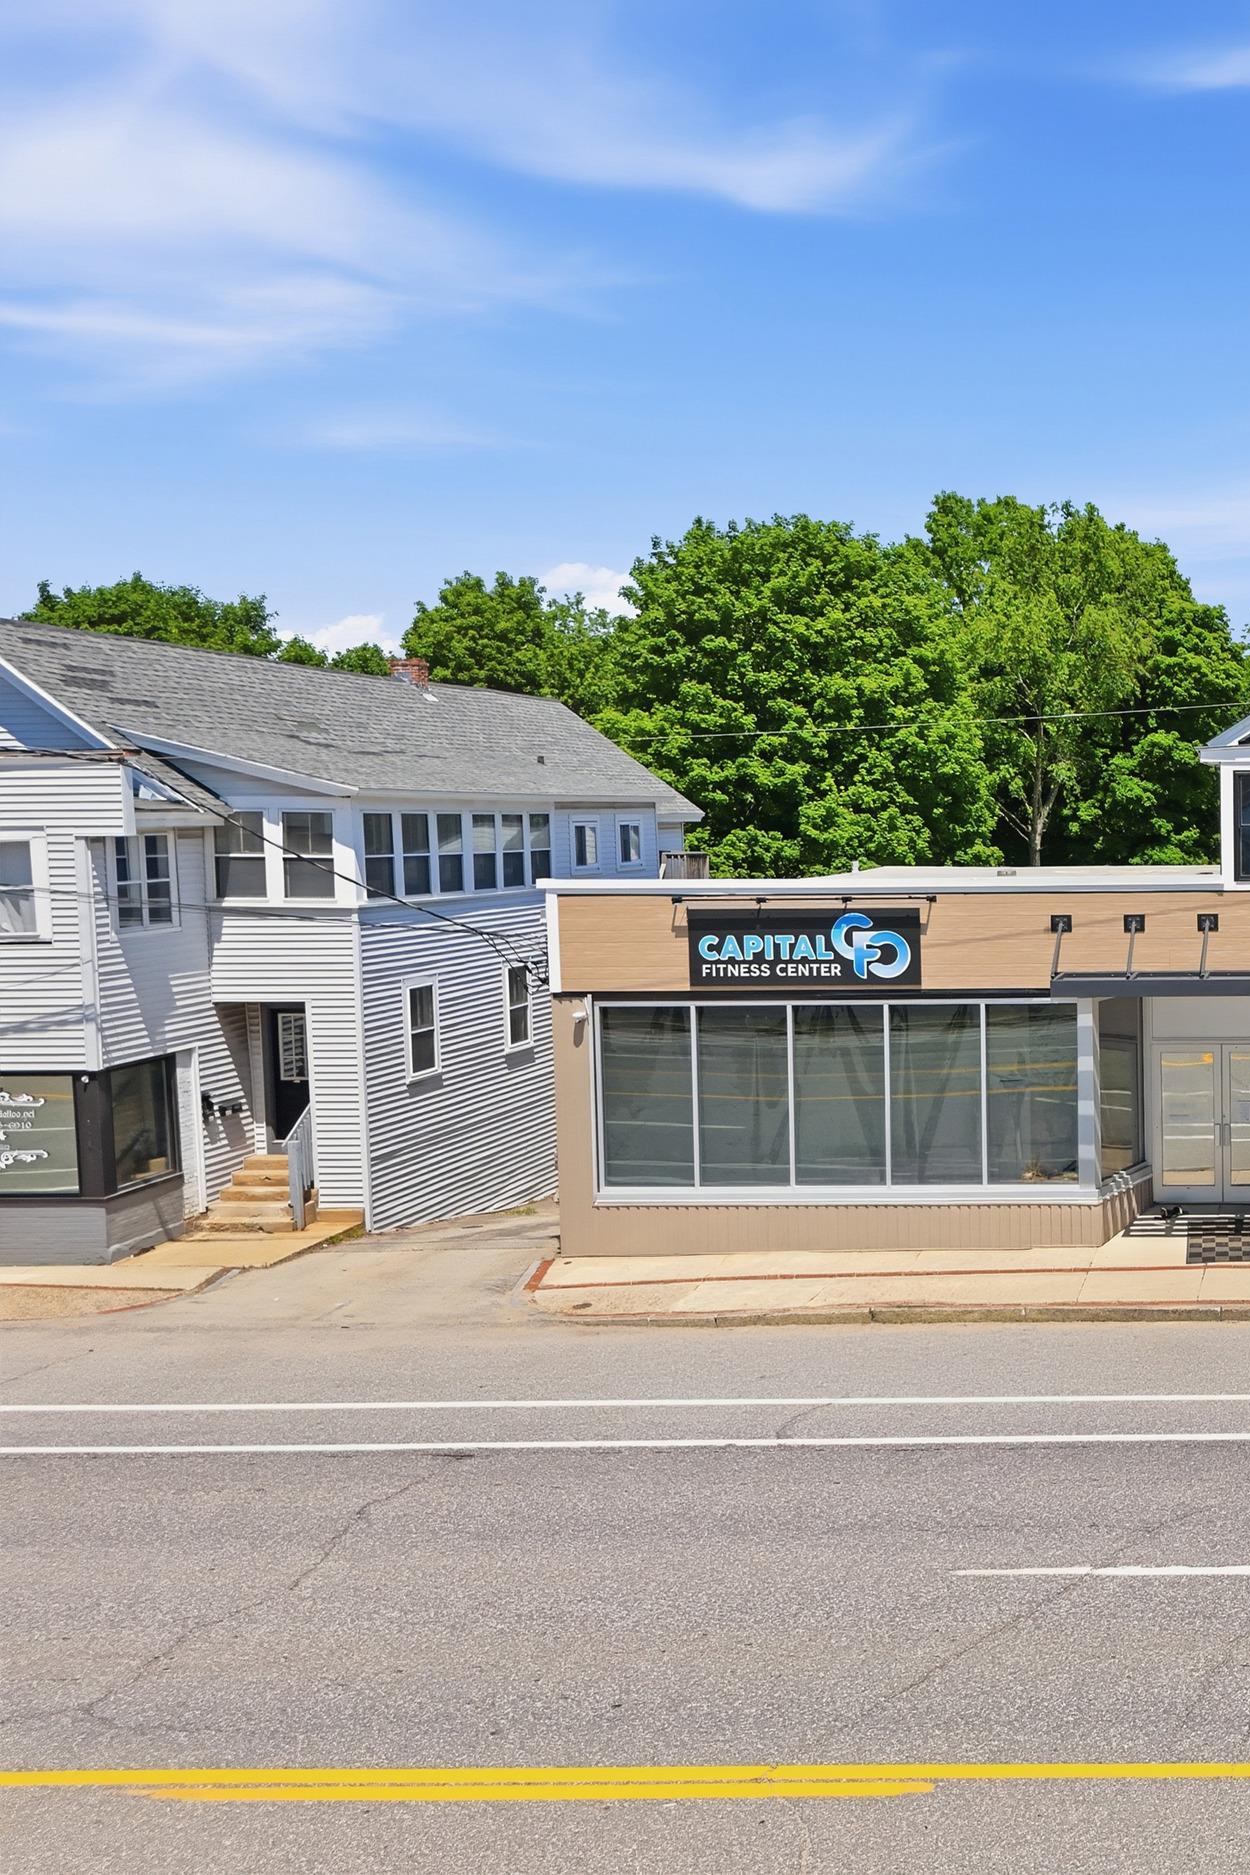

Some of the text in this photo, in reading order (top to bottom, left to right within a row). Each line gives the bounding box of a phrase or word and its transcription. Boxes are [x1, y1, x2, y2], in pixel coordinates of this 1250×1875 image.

[698, 934, 834, 961] CAPITAL
[702, 963, 842, 977] FITNESS CENTER
